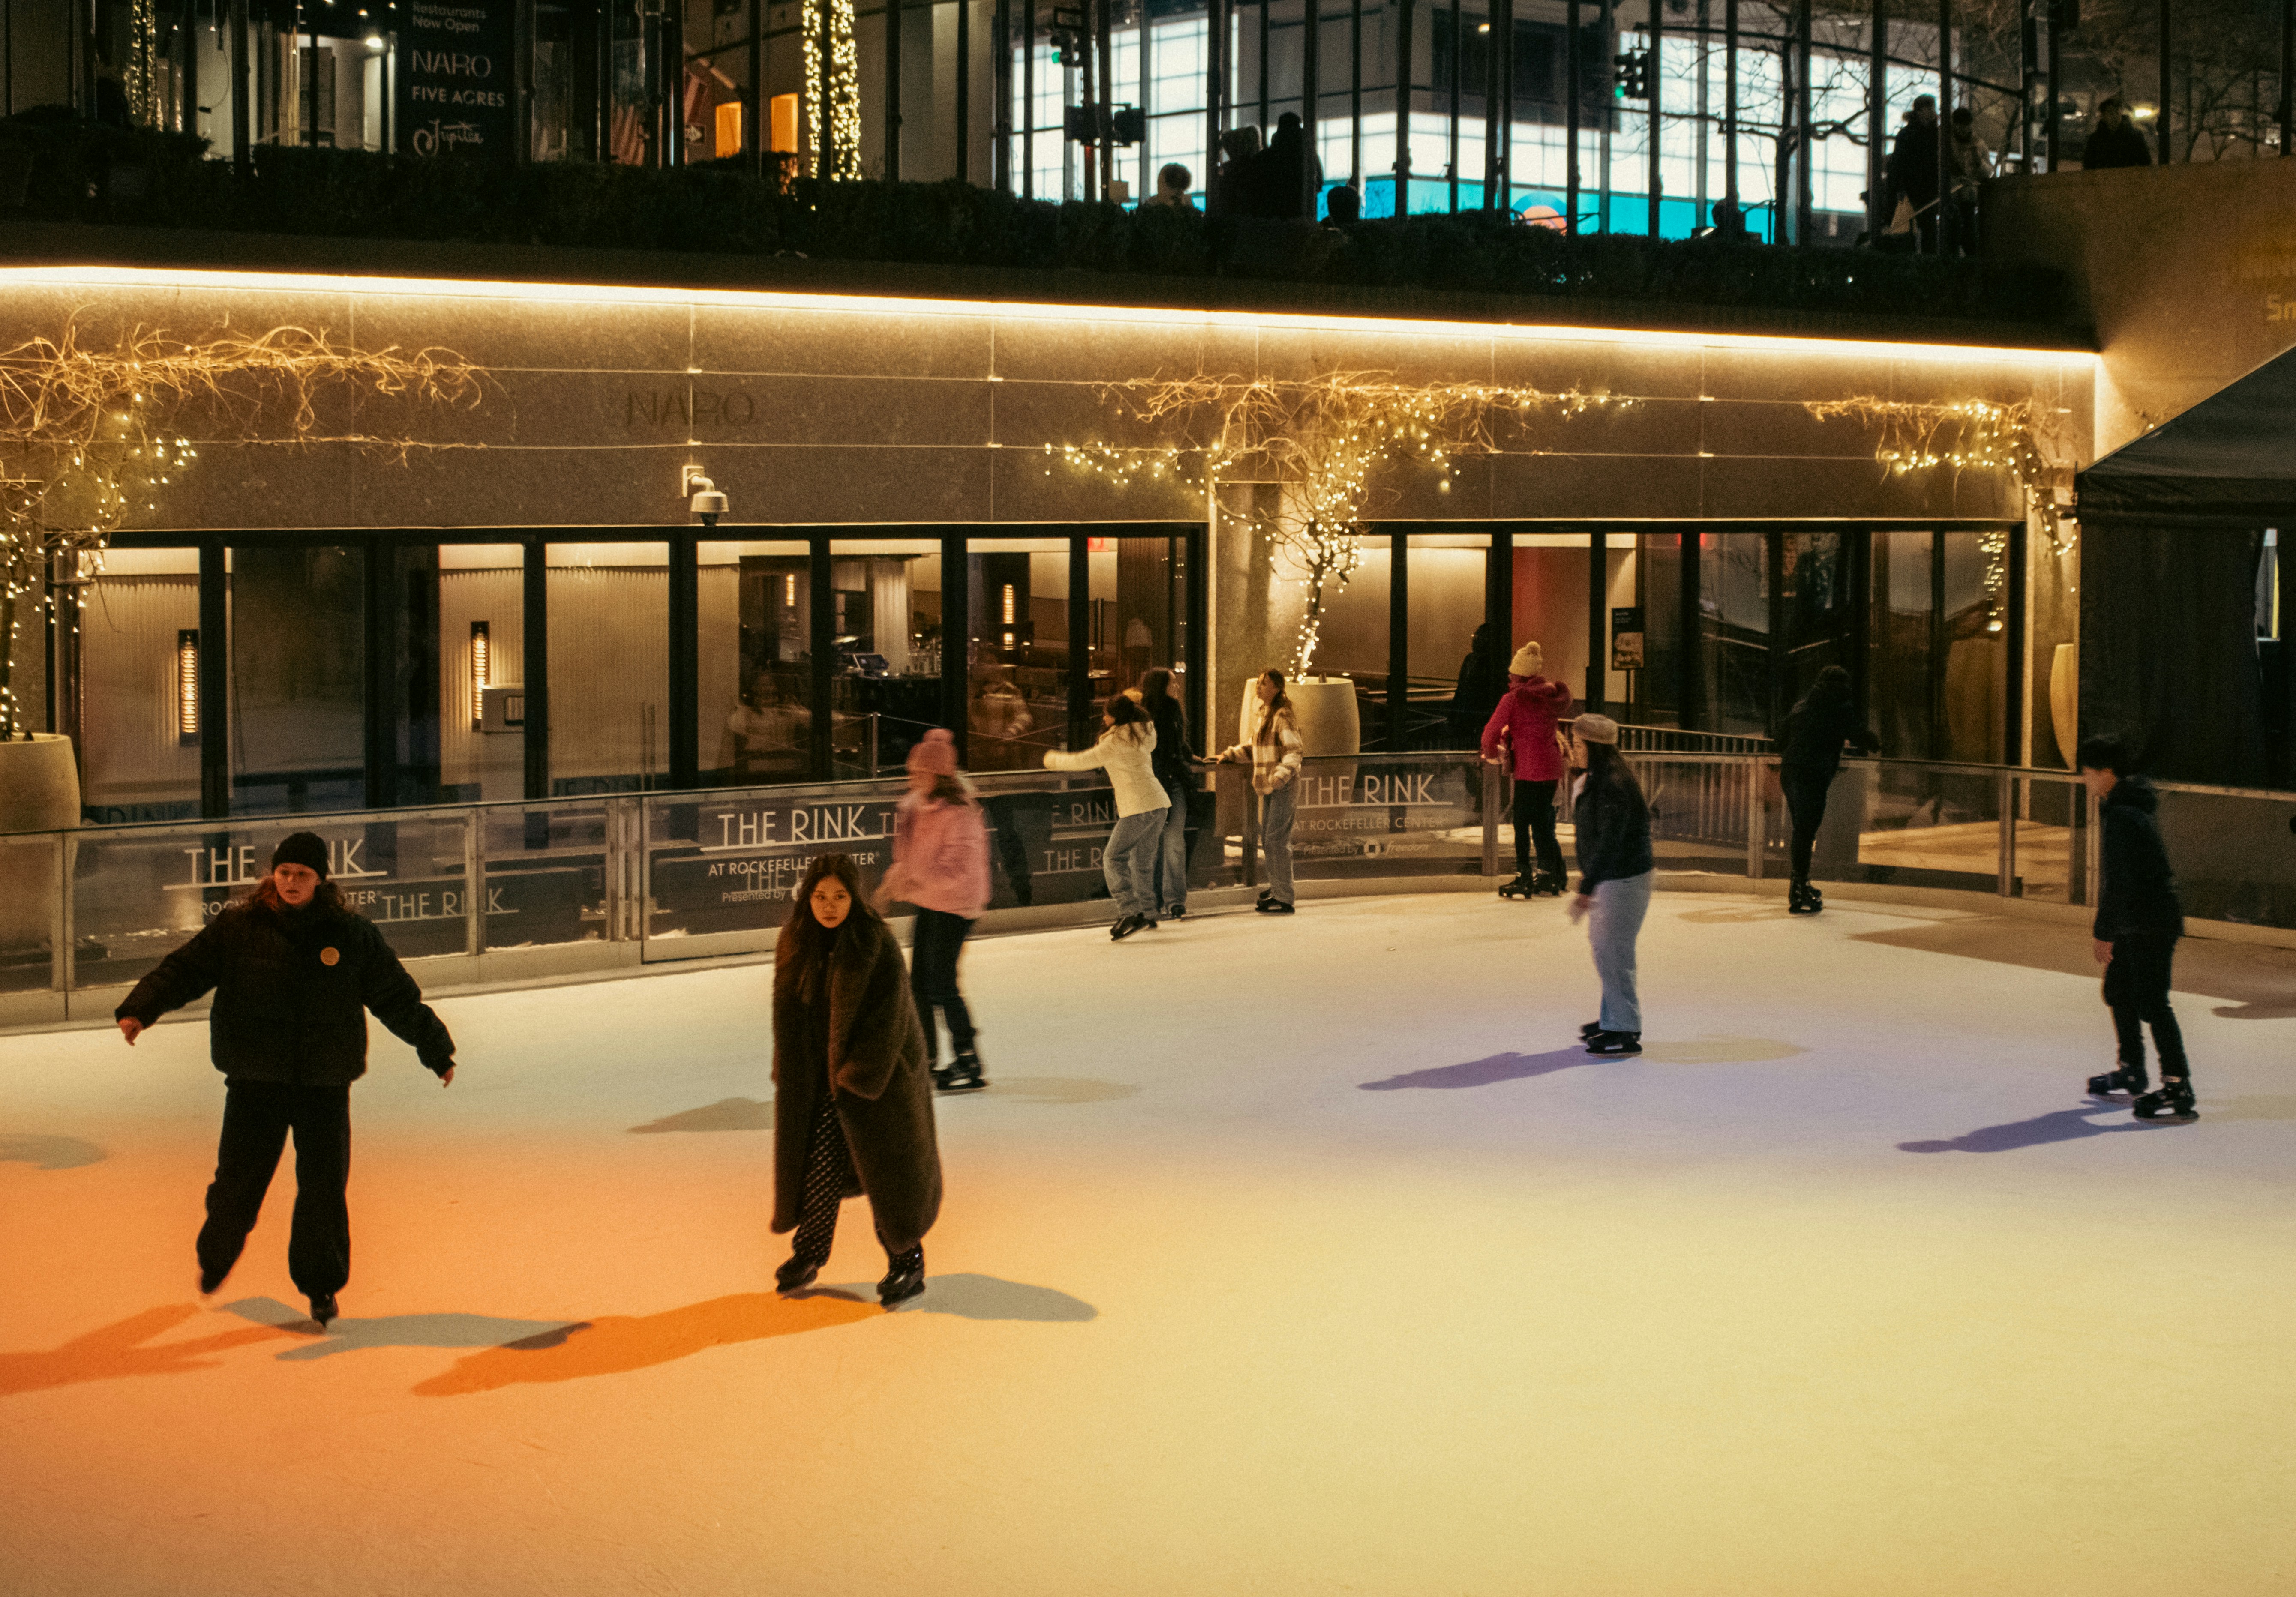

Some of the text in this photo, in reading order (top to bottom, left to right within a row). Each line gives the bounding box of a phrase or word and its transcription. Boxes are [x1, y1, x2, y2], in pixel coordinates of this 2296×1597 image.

[412, 15, 479, 33] Now Open
[412, 49, 491, 78] NARO
[412, 86, 505, 107] FIVE ACRES
[626, 391, 755, 427] NARO
[1300, 774, 1434, 805] THE RINK
[718, 805, 865, 846] THE RINK
[1293, 820, 1306, 831] AT
[1310, 817, 1390, 831] ROCKEFELLER
[184, 845, 256, 885] THE
[708, 863, 725, 876] AT
[1044, 849, 1081, 872] THE
[382, 887, 503, 920] THE RIK
[722, 888, 786, 902] Presented by
